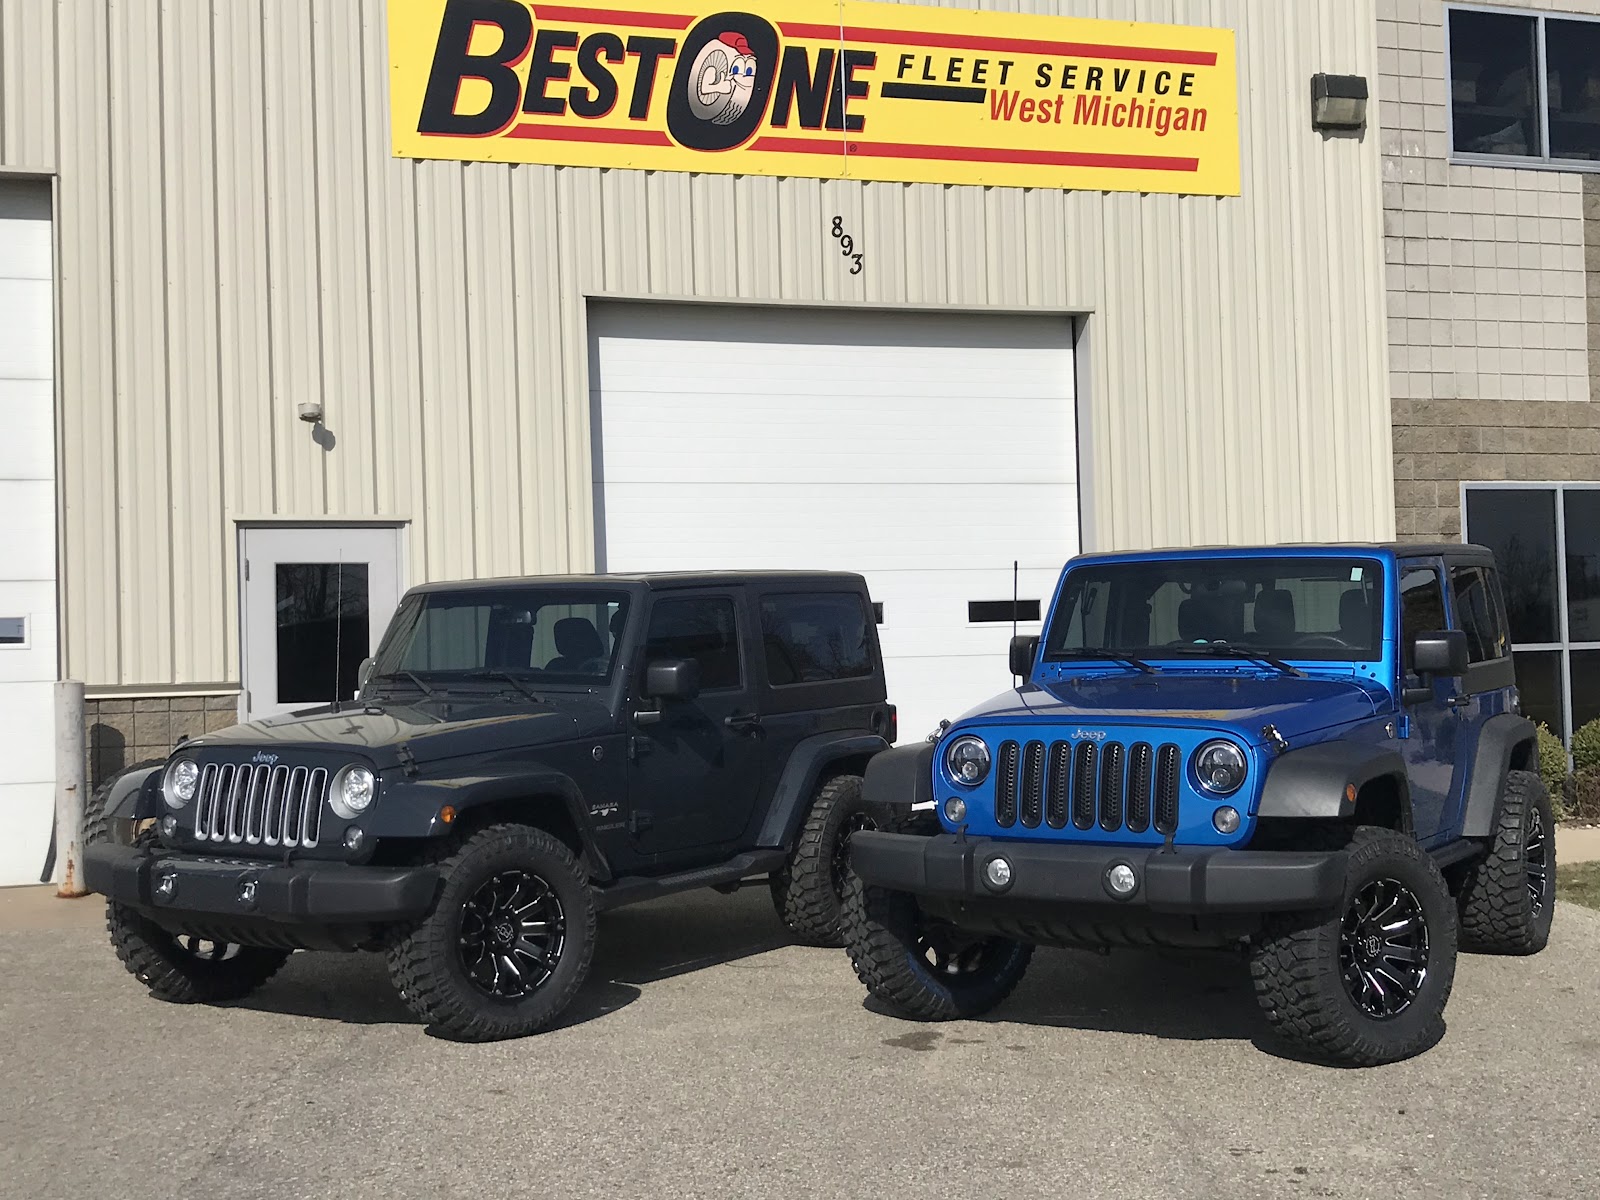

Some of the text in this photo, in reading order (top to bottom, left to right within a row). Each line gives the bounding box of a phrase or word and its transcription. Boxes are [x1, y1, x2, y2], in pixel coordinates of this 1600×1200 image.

[897, 54, 1195, 96] FLEET SERVICE
[990, 89, 1208, 137] West Michigan
[831, 215, 863, 275] 893
[1071, 728, 1106, 741] Jeep
[252, 750, 279, 764] Jeep
